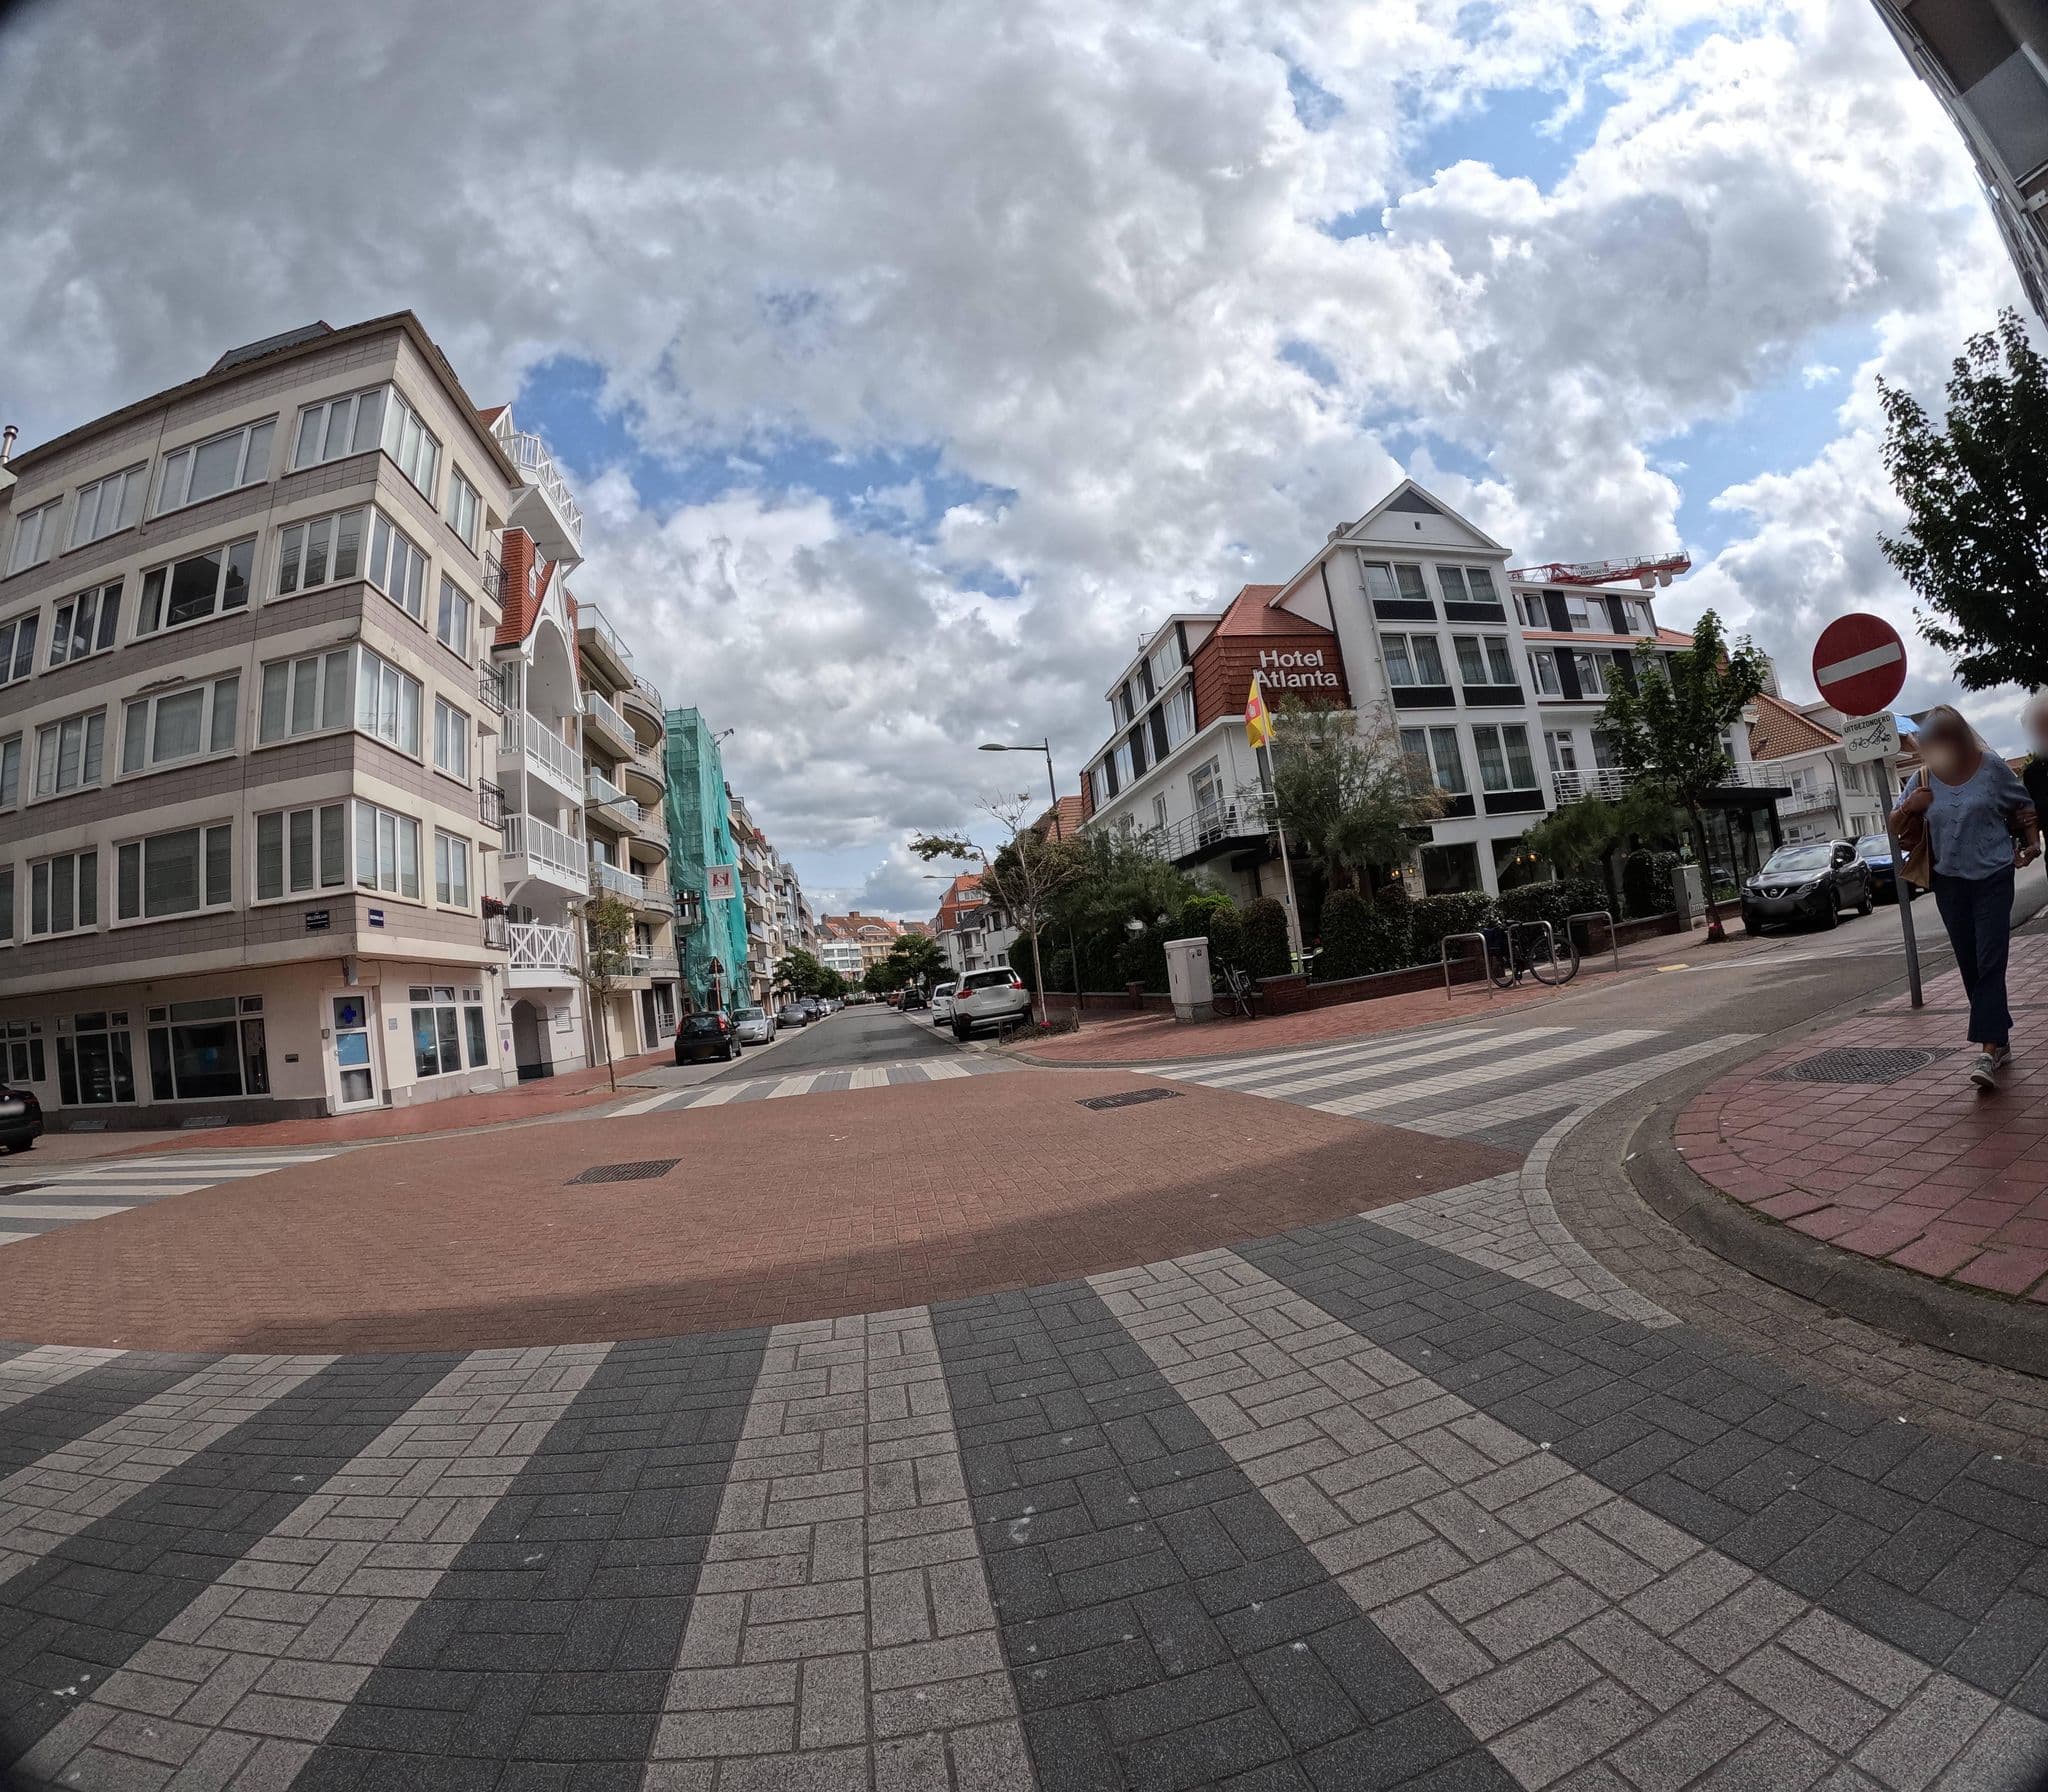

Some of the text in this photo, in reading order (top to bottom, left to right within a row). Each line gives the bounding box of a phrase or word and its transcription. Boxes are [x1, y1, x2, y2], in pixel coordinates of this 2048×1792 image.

[1259, 649, 1324, 668] Hotel
[1256, 670, 1339, 688] Atlanta
[1844, 715, 1891, 733] UITGEZONDERD
